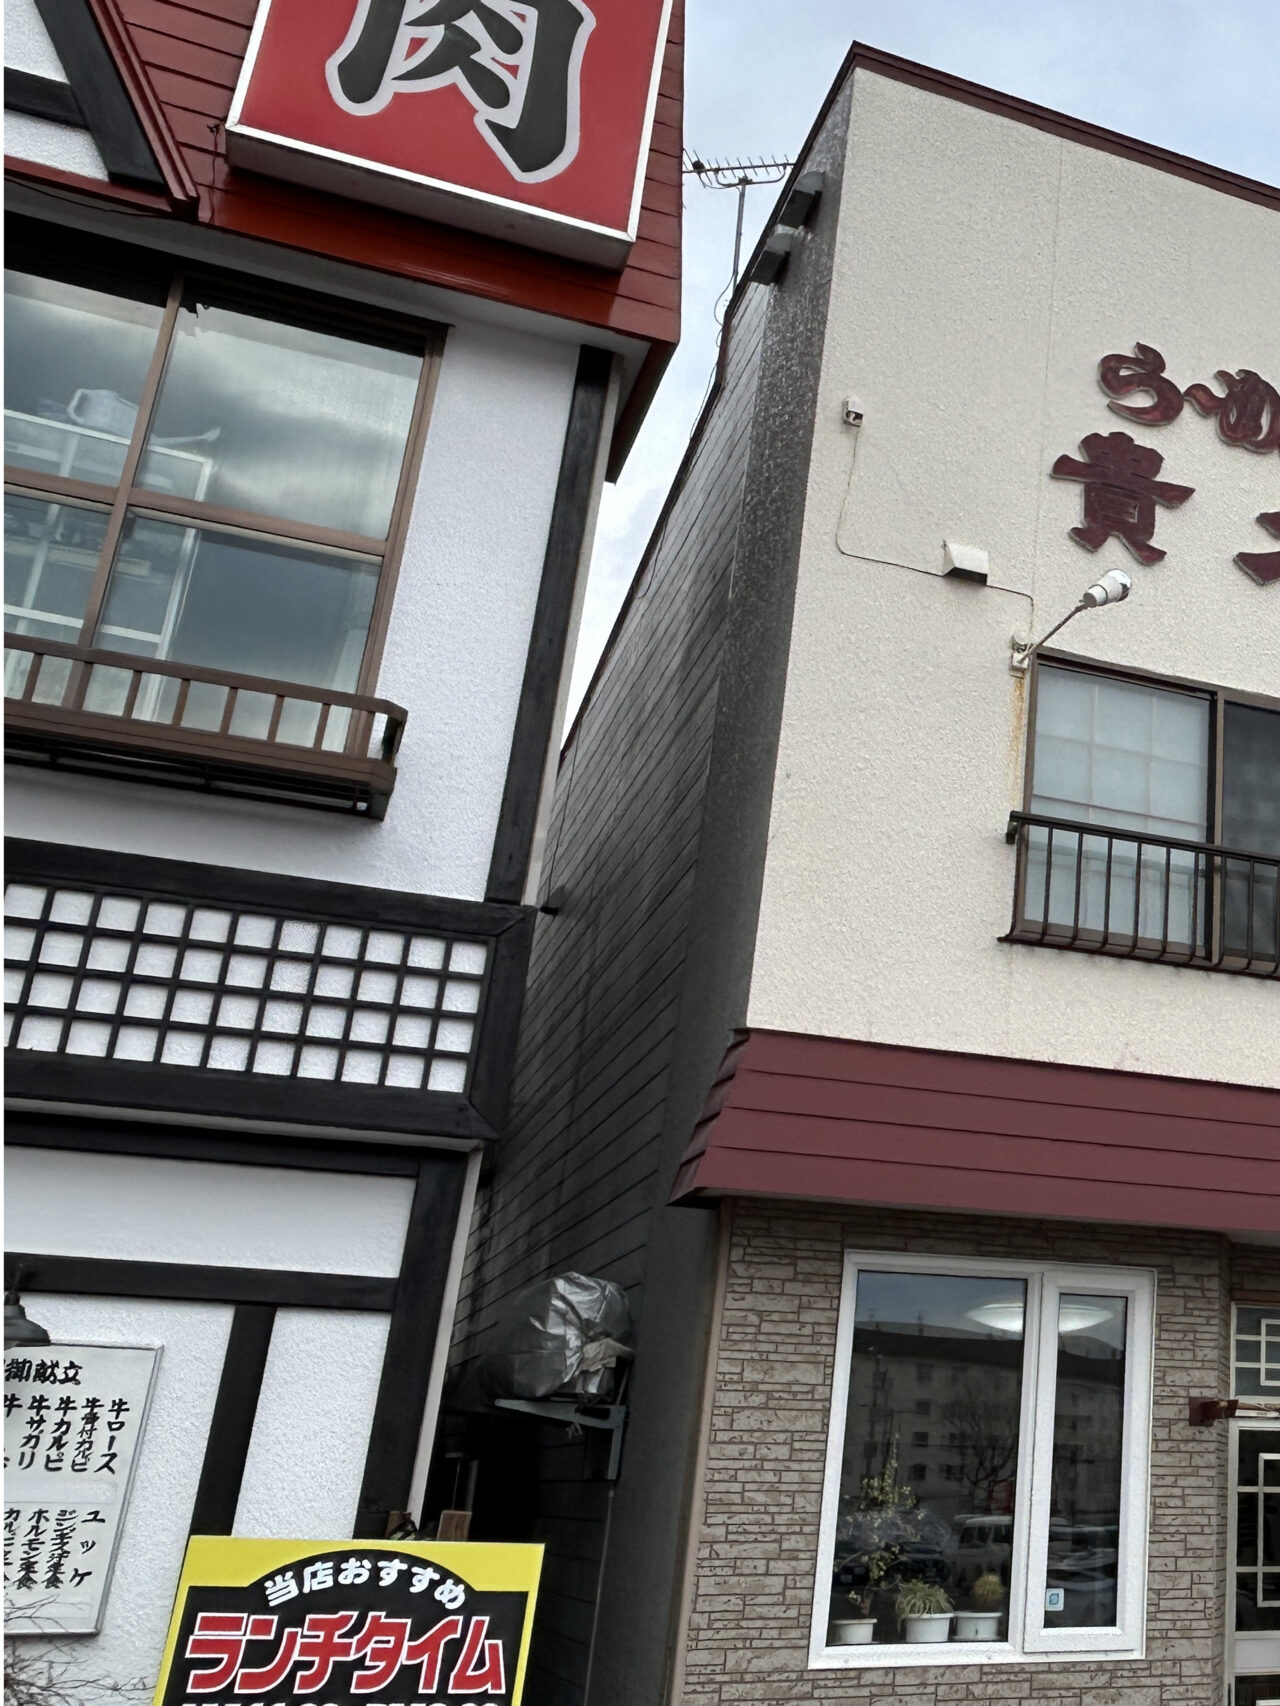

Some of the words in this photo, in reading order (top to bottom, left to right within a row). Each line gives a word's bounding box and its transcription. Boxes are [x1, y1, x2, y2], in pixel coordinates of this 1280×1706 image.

[325, 0, 596, 183] 肉
[19, 1394, 51, 1470] 牛サガリ
[94, 1398, 130, 1474] 牛ロース
[69, 1510, 106, 1588] ユッケ
[264, 1556, 467, 1610] 当店おすすめ
[184, 1610, 506, 1695] ランチタイム
